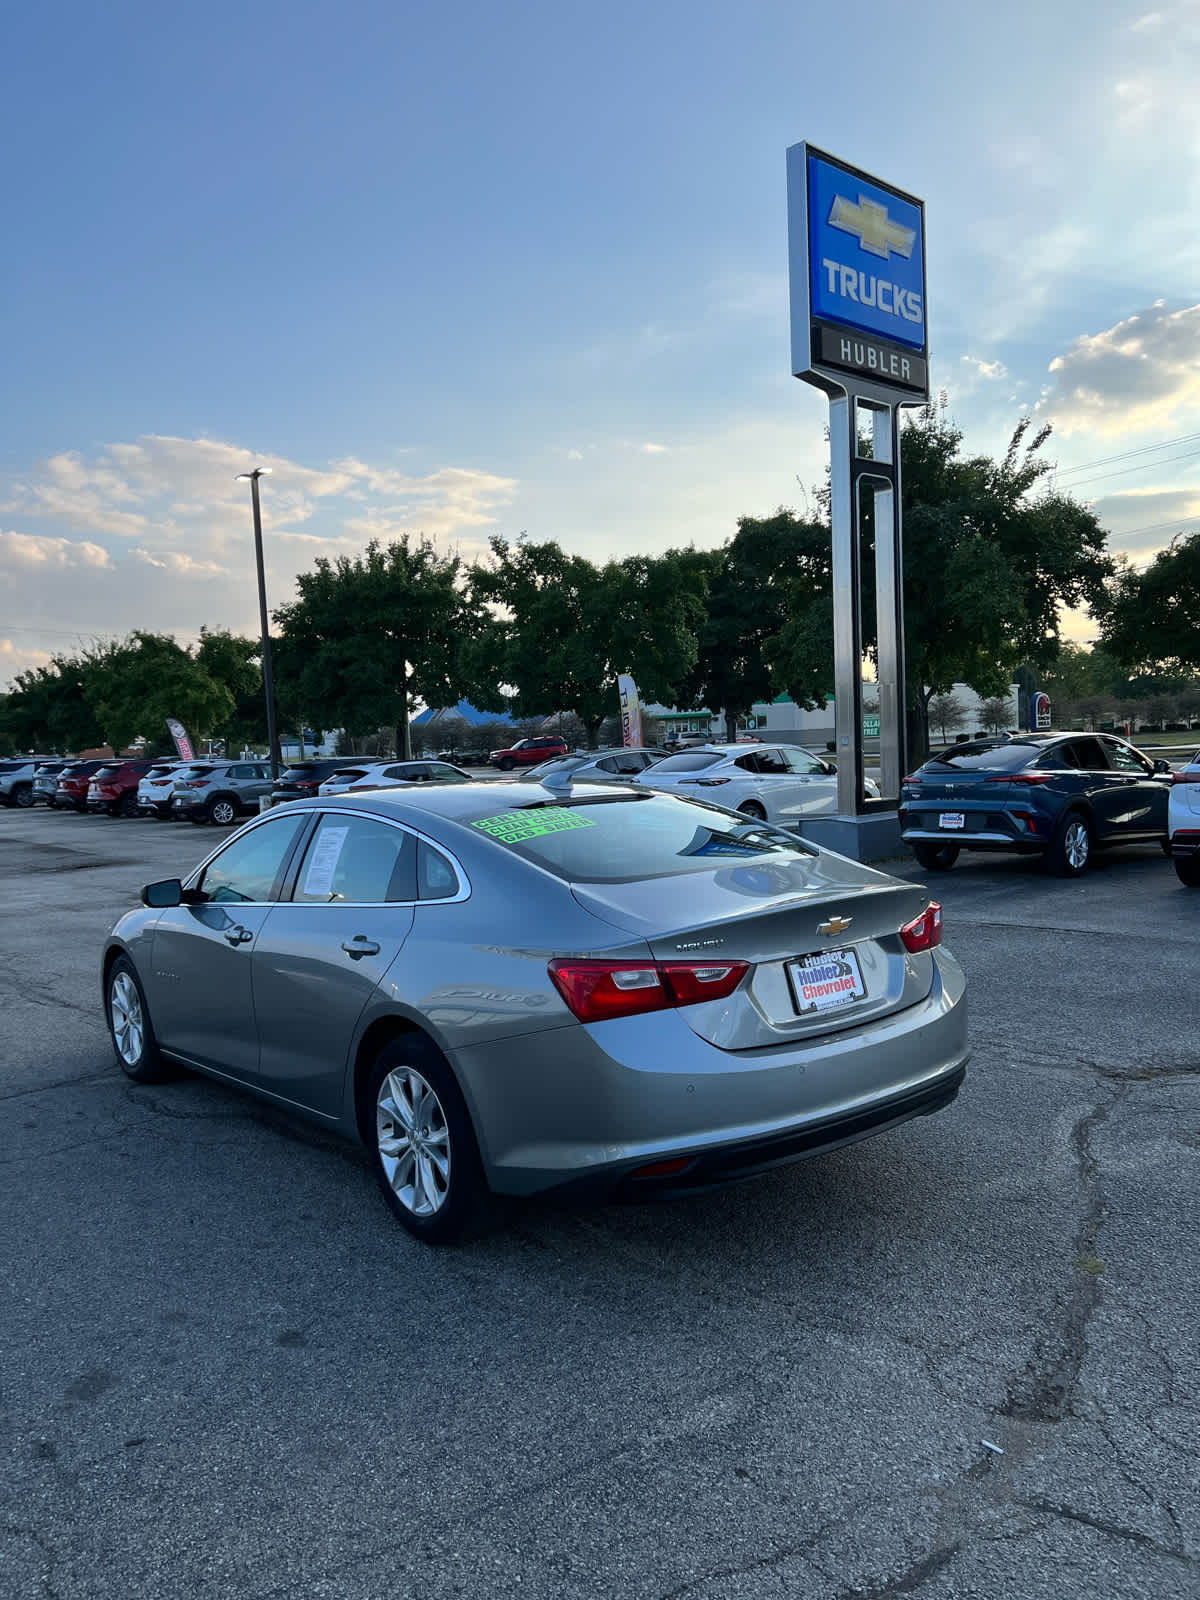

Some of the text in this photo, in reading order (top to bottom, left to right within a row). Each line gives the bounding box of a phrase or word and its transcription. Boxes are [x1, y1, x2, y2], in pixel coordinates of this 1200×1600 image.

[822, 258, 922, 324] TRUCKS
[841, 338, 910, 380] HUBLER
[490, 819, 531, 835] CLEAN
[504, 829, 536, 842] GAS
[798, 966, 838, 986] Hubler
[802, 976, 856, 999] Chevrolet
